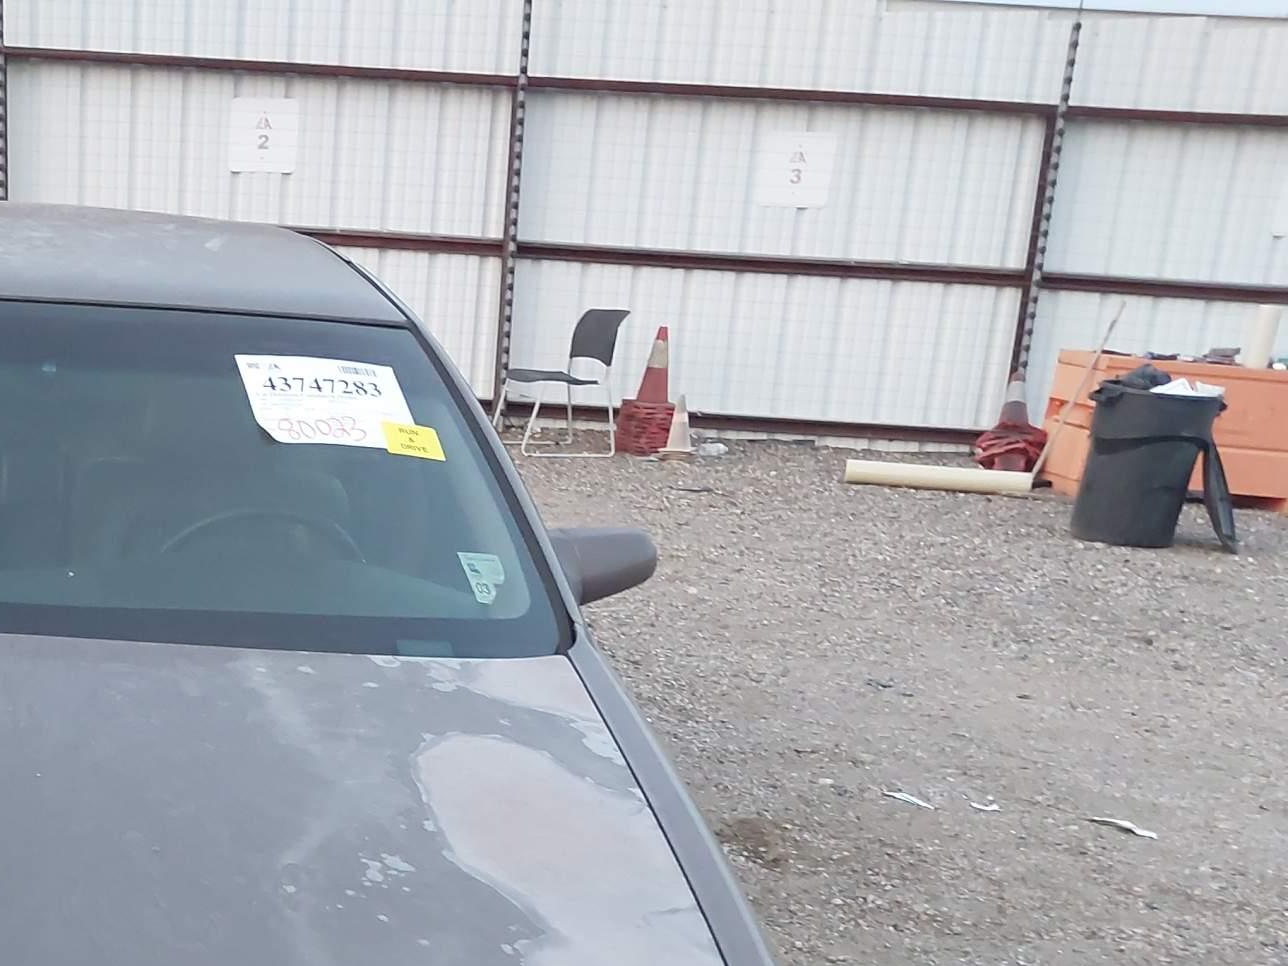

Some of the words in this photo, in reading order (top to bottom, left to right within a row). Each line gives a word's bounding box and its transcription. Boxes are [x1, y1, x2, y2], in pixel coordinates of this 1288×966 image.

[257, 134, 270, 150] 2
[789, 168, 802, 185] 3
[263, 376, 383, 397] 43747283
[400, 443, 430, 453] DRIVE
